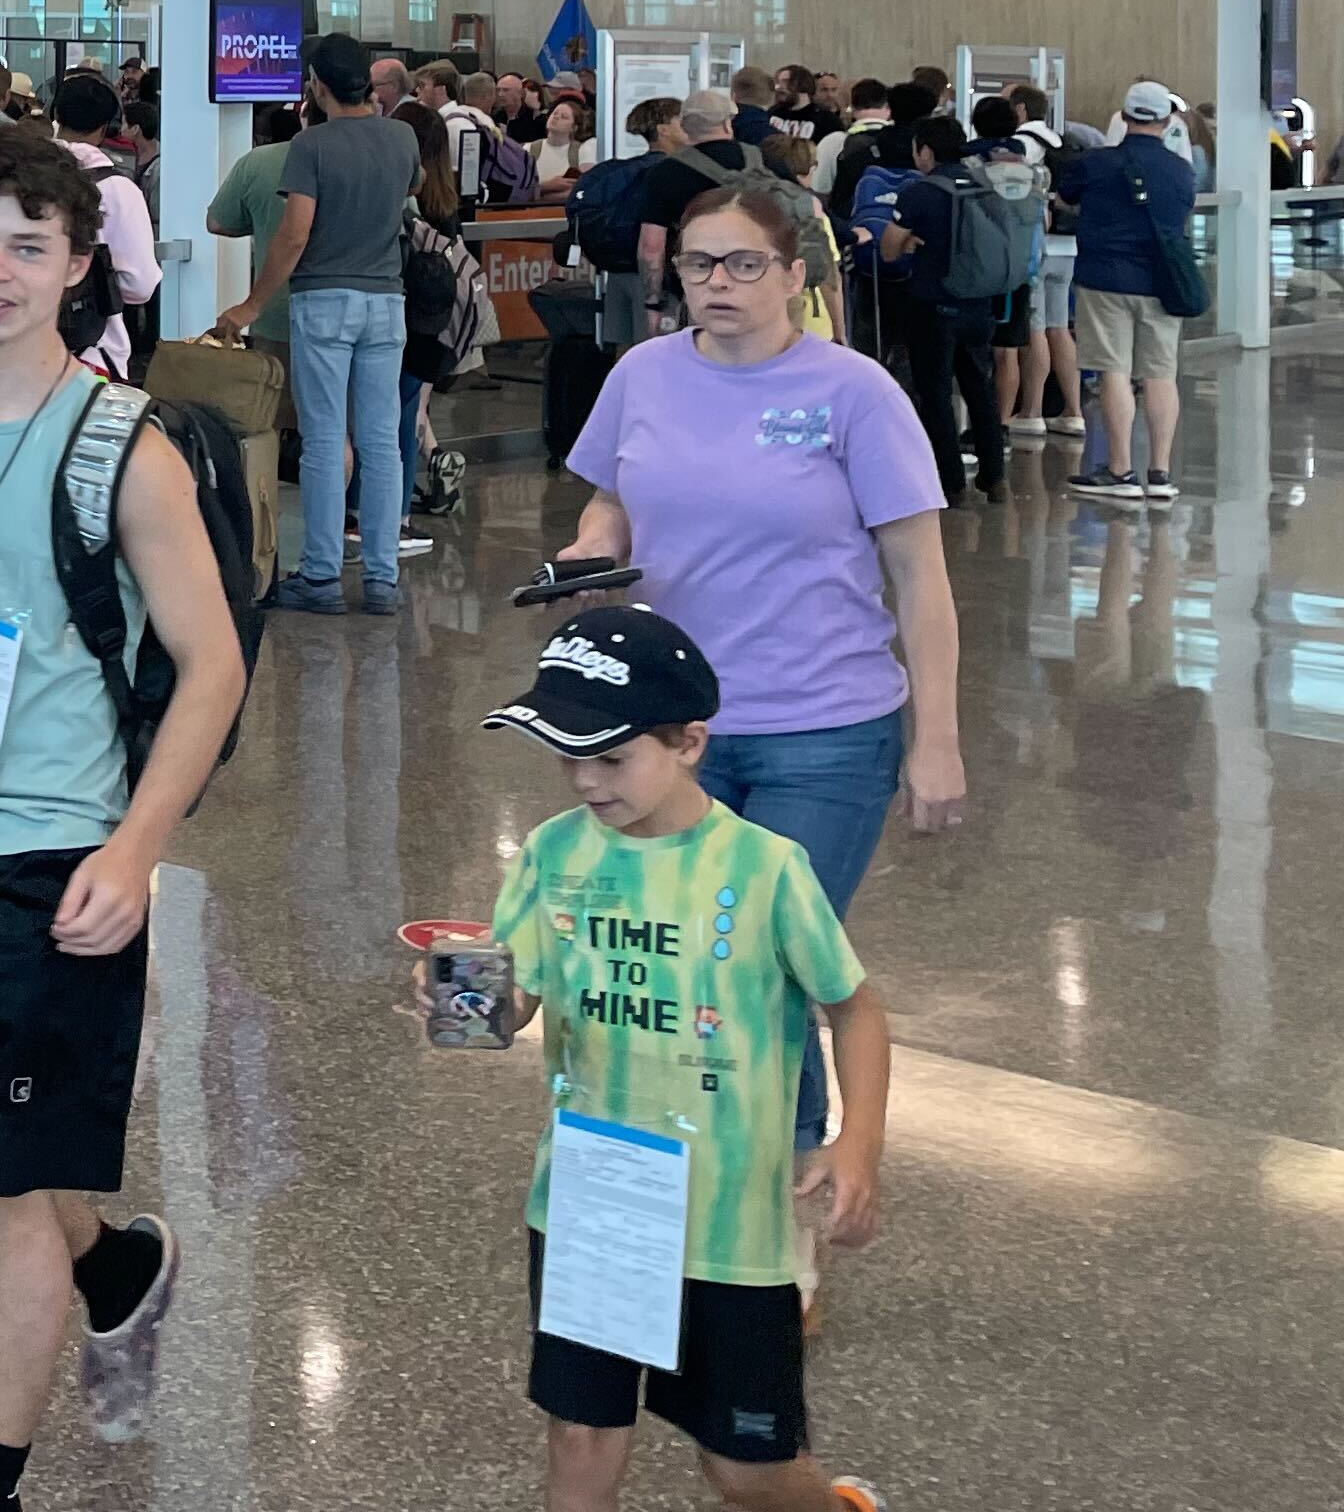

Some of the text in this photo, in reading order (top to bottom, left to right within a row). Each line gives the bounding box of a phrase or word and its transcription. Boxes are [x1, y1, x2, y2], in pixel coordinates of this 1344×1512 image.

[221, 34, 297, 59] PROPEL
[489, 253, 553, 292] Enter
[587, 916, 680, 957] TIME
[607, 959, 648, 985] TO
[580, 988, 679, 1034] MINE
